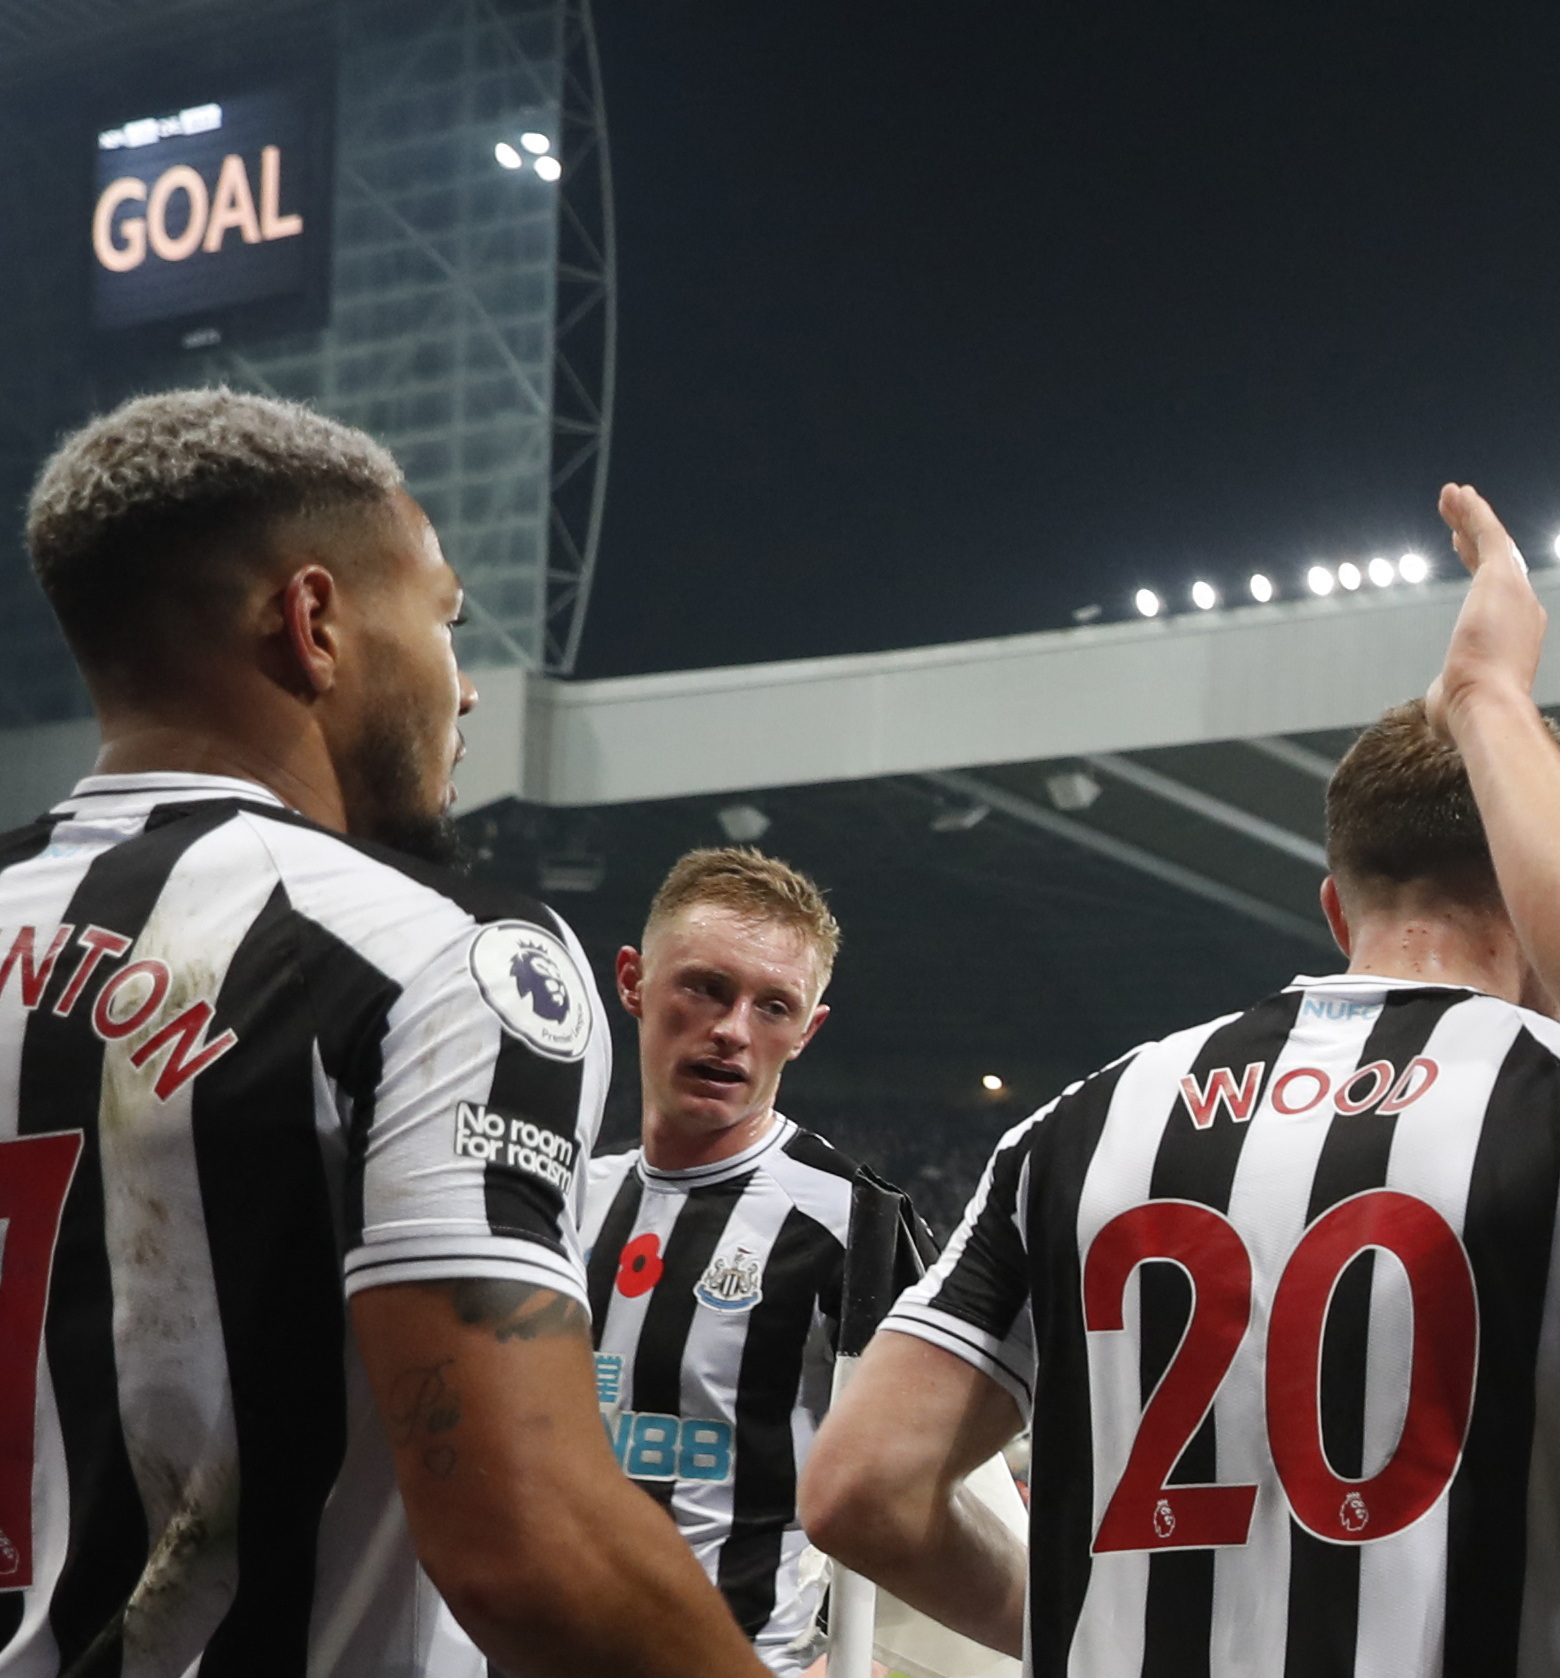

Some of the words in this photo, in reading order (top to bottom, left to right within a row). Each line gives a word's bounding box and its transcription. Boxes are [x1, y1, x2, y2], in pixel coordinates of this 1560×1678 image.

[93, 145, 303, 272] GOAL
[0, 922, 239, 1104] NTON
[1303, 1000, 1384, 1020] NUFC
[1180, 1056, 1440, 1130] WOOD
[455, 1129, 503, 1161] for
[507, 1144, 573, 1194] racism
[458, 1102, 505, 1137] No
[510, 1118, 574, 1166] room
[1081, 1187, 1481, 1558] 20
[600, 1412, 734, 1481] N88
